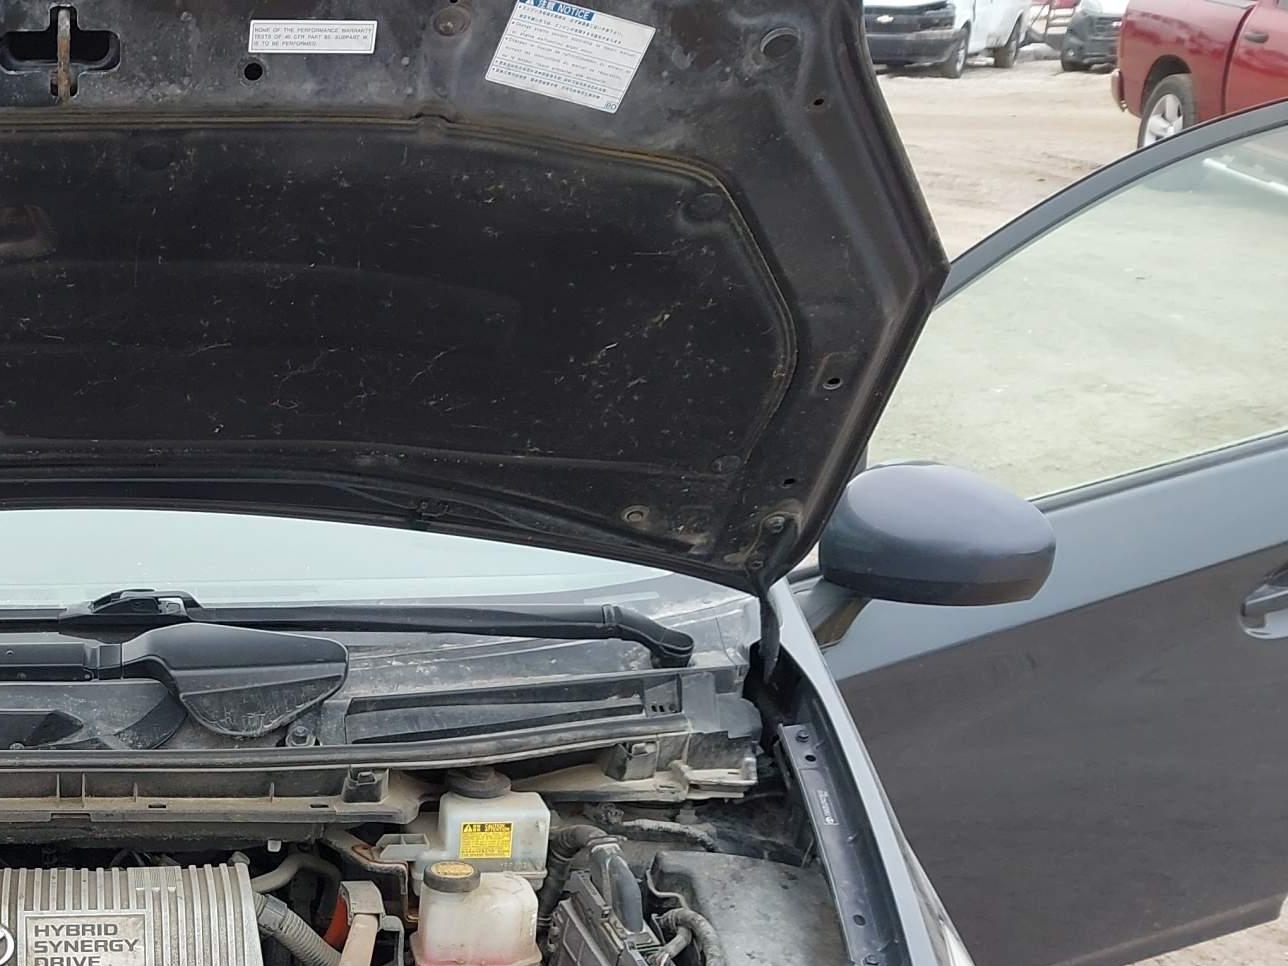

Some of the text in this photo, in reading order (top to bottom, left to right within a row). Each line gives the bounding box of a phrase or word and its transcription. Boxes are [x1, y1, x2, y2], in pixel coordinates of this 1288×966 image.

[557, 5, 589, 20] NOTICE
[34, 924, 118, 937] HYBRID
[34, 940, 139, 954] SYNERGY
